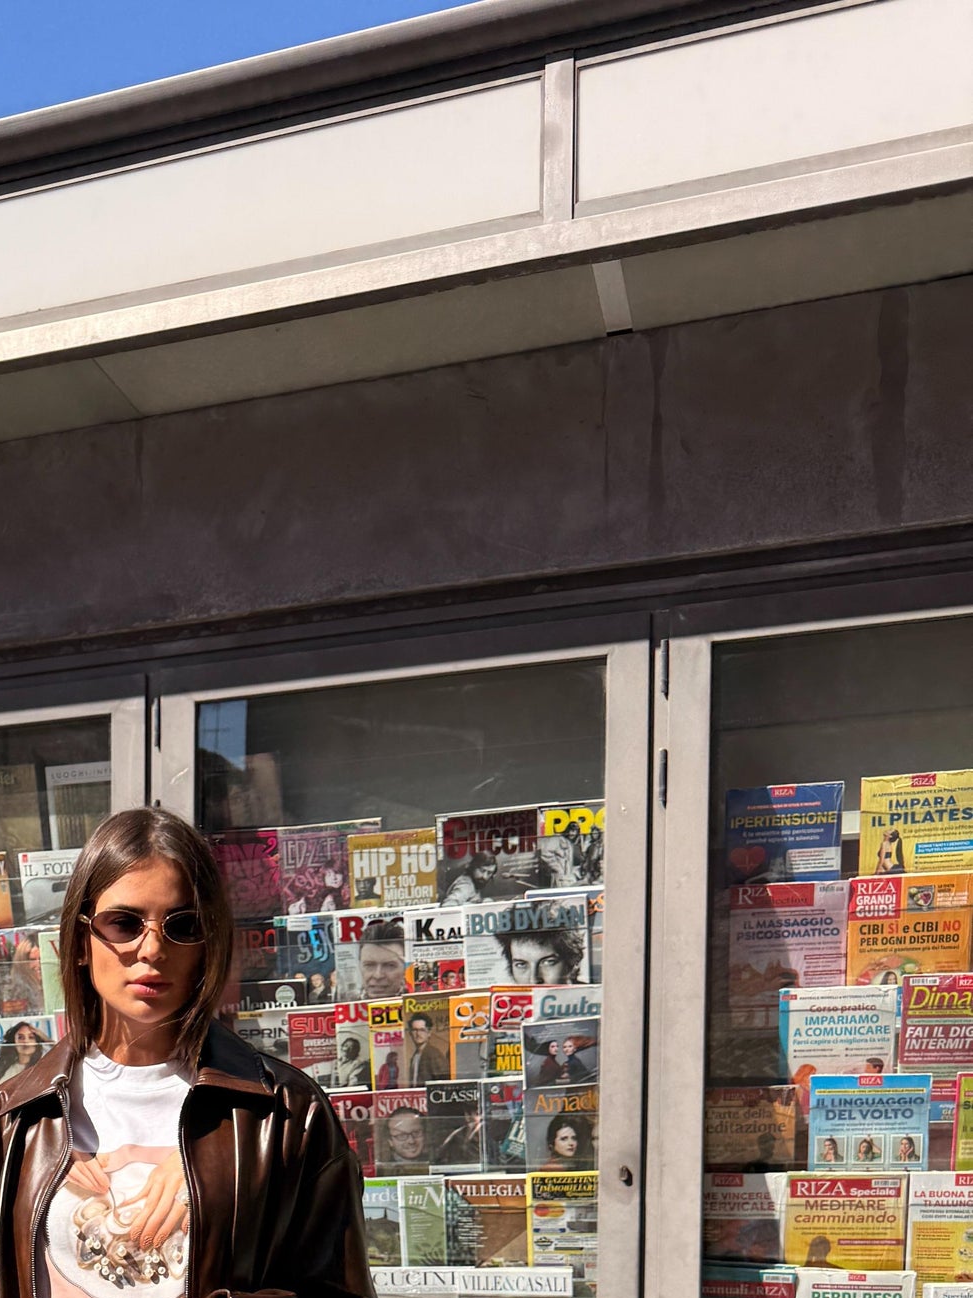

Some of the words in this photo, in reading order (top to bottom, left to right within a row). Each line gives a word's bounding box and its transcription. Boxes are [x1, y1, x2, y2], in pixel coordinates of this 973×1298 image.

[889, 795, 957, 811] IMPARA
[730, 811, 837, 829] IPERTENSIONE
[871, 816, 886, 828] IL
[889, 807, 973, 826] PILATES
[24, 864, 38, 877] IL
[43, 861, 75, 875] FOT
[352, 846, 396, 879] HIP
[384, 876, 397, 889] LE
[398, 874, 417, 888] 100
[856, 881, 897, 896] RIZA
[384, 885, 434, 901] MIGLIORI
[856, 893, 897, 905] GRANDI
[368, 912, 401, 925] CLASSIC
[856, 905, 896, 918] GUIDE
[469, 910, 513, 935] BOB
[514, 904, 586, 932] DYLAN
[743, 920, 755, 931] IL
[756, 917, 834, 930] MASSAGGIO
[737, 926, 841, 941] PSICOSOMATICO
[859, 923, 884, 936] CIBI
[888, 919, 899, 935] SÌ
[902, 925, 910, 934] e
[914, 921, 939, 933] CIBI
[942, 920, 962, 932] NO
[860, 936, 878, 947] PER
[880, 935, 907, 946] OGNI
[908, 933, 960, 945] DISTURBO
[909, 986, 973, 1009] Dima
[810, 1004, 838, 1013] Corso
[840, 1002, 877, 1014] pratico
[805, 1014, 880, 1026] IMPARIAMO
[793, 1027, 802, 1038] A
[804, 1024, 891, 1038] COMUNICARE
[905, 1026, 929, 1039] FAI
[932, 1026, 945, 1038] IL
[904, 1038, 973, 1051] INTERMIT
[860, 1076, 882, 1086] RIZA
[815, 1098, 828, 1109] IL
[830, 1096, 925, 1108] LINGUAGGIO
[825, 1108, 856, 1121] DEL
[858, 1107, 914, 1120] VOLTO
[795, 1181, 847, 1196] RIZA
[848, 1187, 896, 1197] Speciale
[914, 1190, 926, 1198] LA
[929, 1190, 965, 1198] BUONA
[804, 1199, 886, 1211] MEDITARE
[793, 1211, 897, 1224] camminando
[756, 1286, 788, 1296] RIZA
